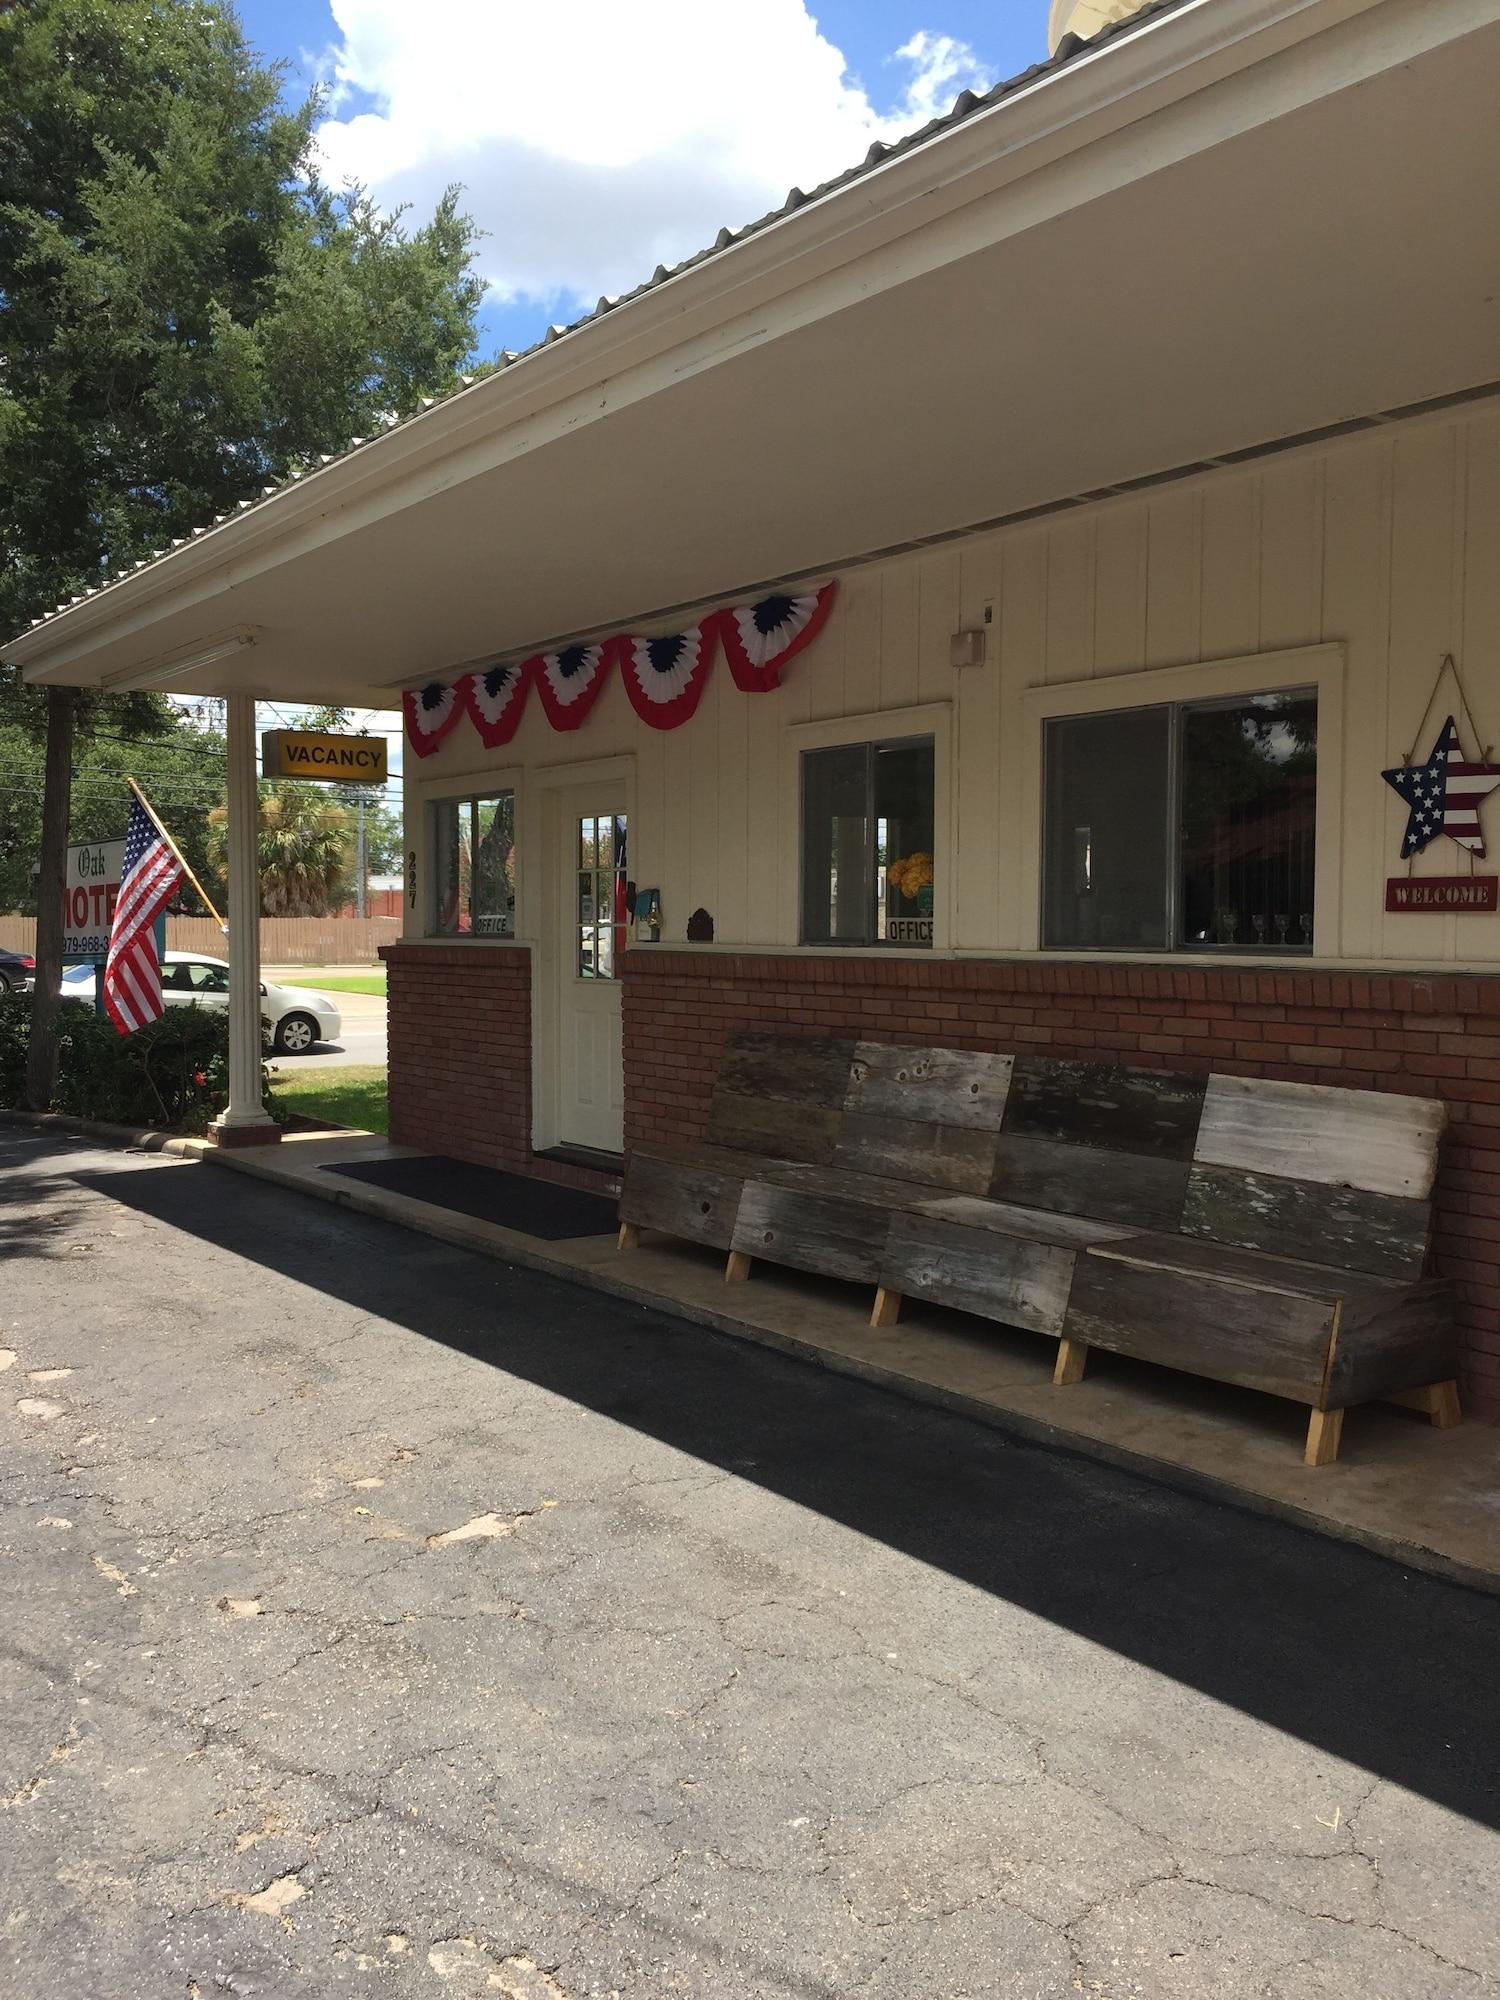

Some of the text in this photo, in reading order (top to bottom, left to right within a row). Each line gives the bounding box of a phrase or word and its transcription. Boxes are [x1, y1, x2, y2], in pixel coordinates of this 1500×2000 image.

[286, 745, 382, 768] VACANCY
[78, 848, 105, 878] Oak
[408, 851, 417, 909] 227
[1395, 886, 1489, 904] WELCOME
[890, 921, 934, 940] OFFICE
